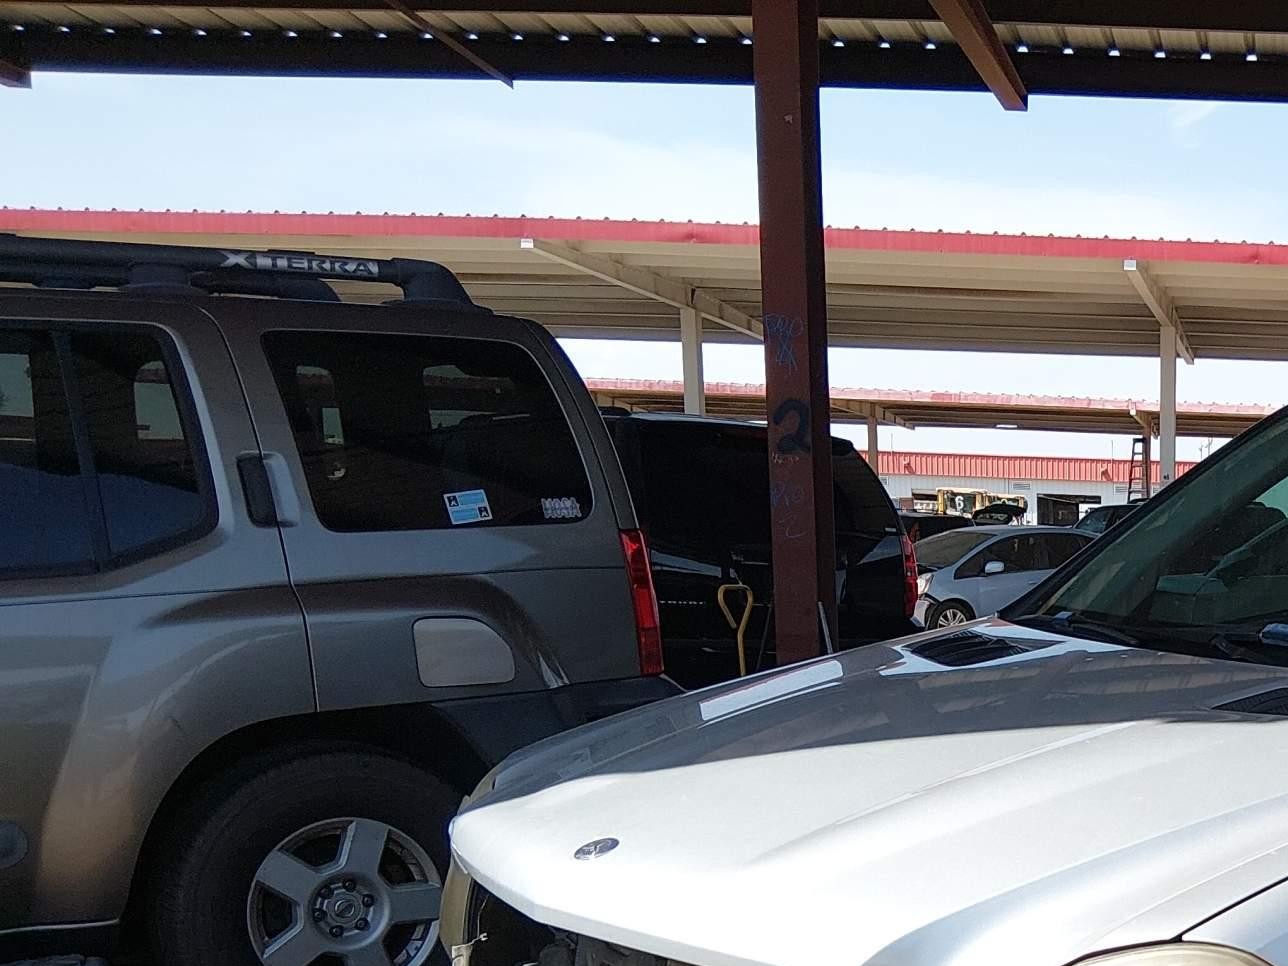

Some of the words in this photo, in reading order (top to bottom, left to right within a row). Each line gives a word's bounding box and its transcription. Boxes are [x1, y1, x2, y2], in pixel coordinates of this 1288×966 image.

[220, 250, 375, 277] XTERRA
[772, 398, 812, 456] 2
[954, 494, 965, 510] 6
